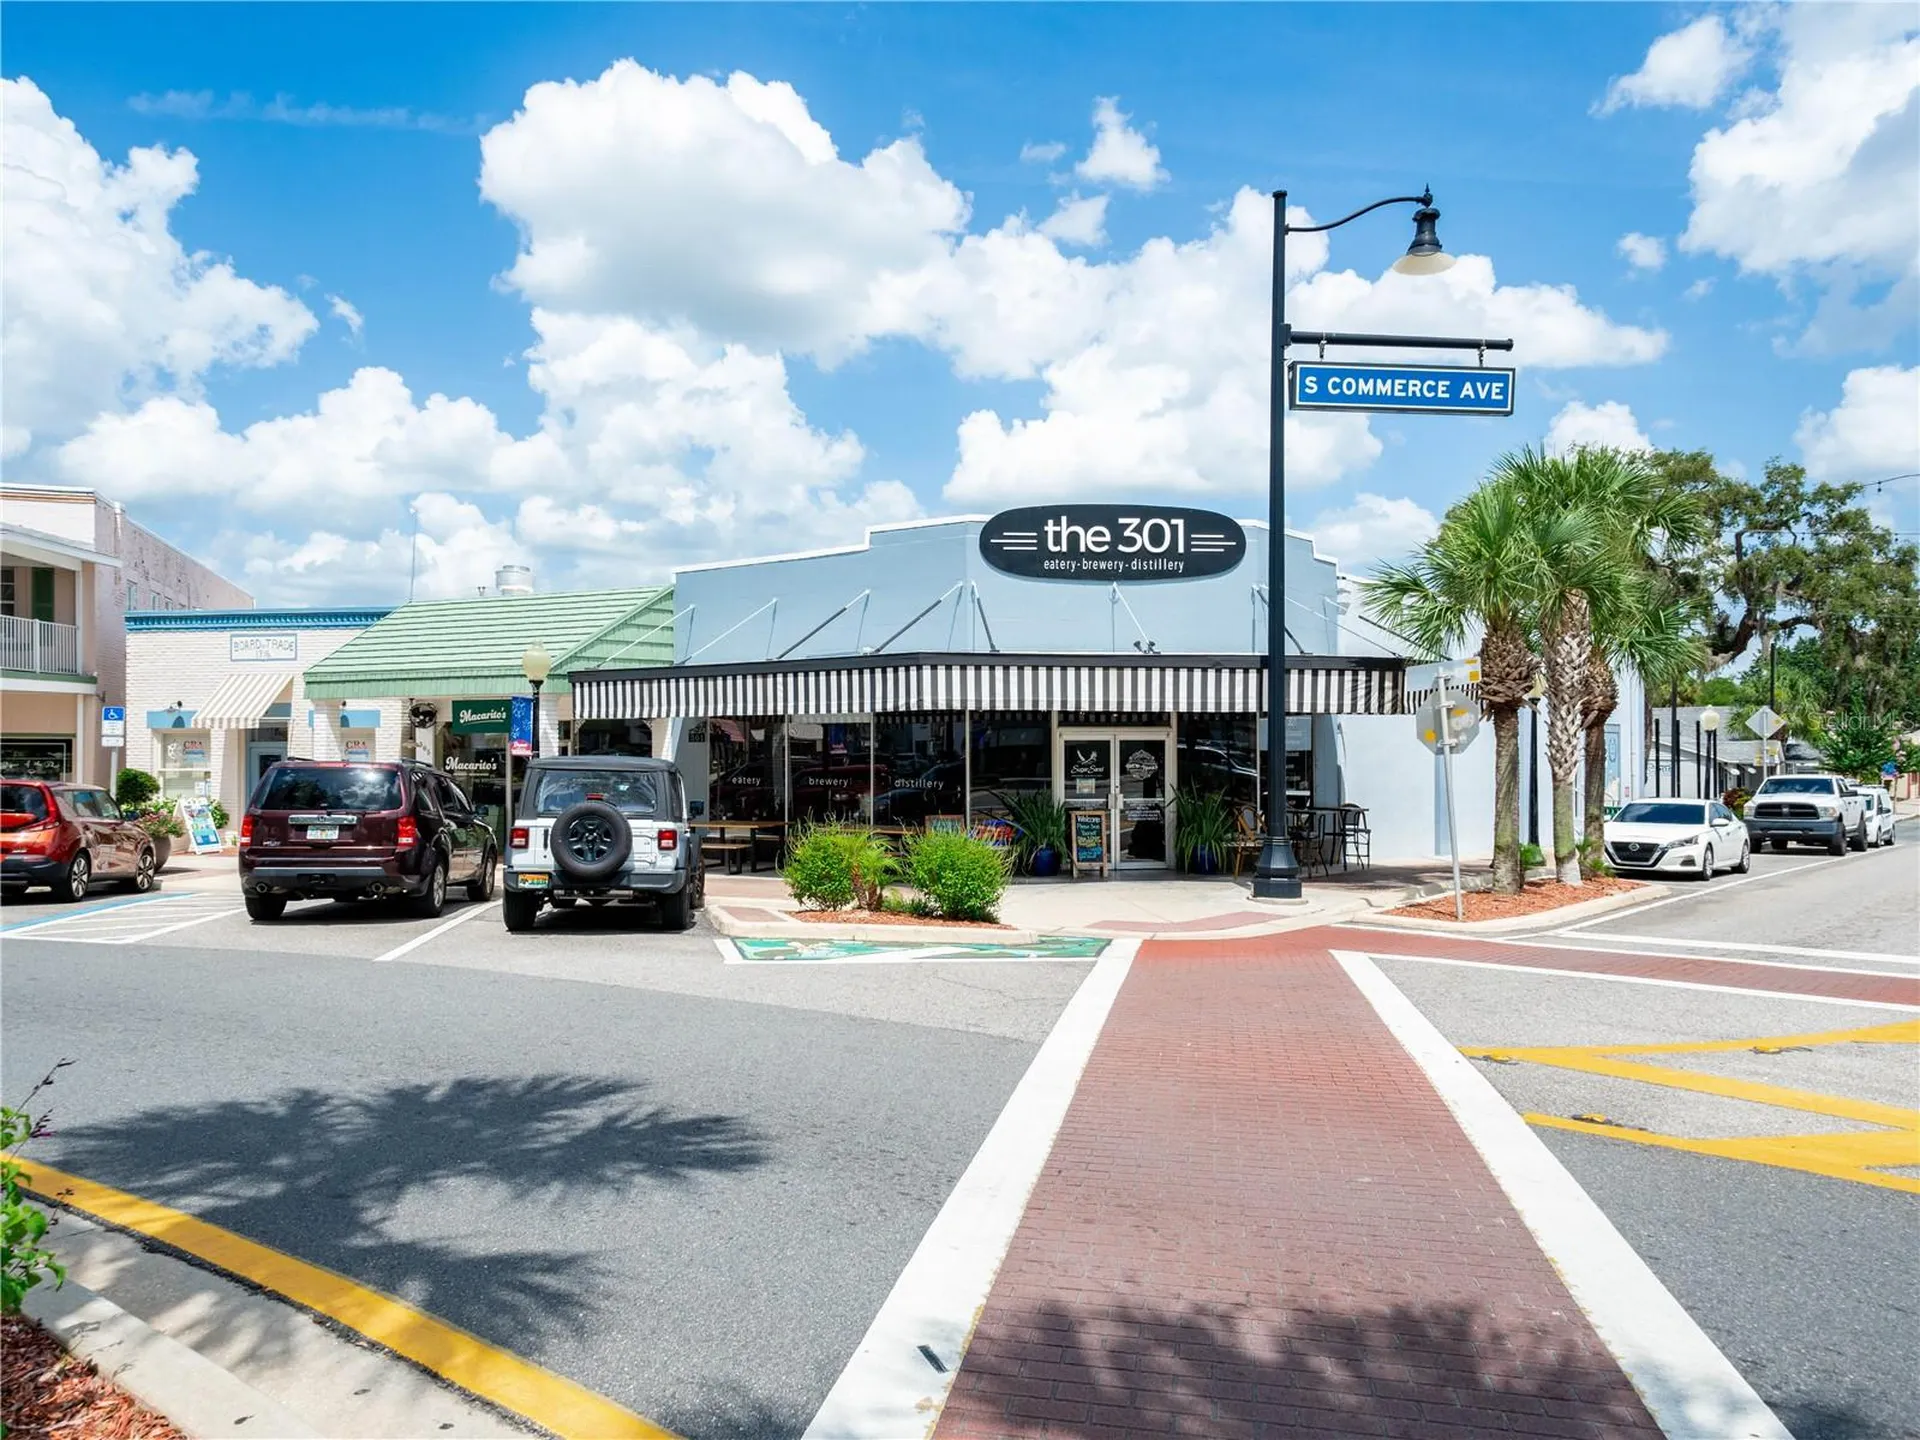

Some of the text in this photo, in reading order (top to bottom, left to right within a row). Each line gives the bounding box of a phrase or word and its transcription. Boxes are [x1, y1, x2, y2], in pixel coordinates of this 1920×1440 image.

[1304, 376, 1504, 400] S COMMERCE AVE
[1043, 515, 1185, 554] the 301
[265, 639, 294, 651] TRADE
[459, 707, 506, 723] Macarito's
[445, 756, 497, 771] Macarito's
[731, 775, 761, 787] eatery
[808, 776, 848, 788] brewery
[894, 777, 944, 791] distillery
